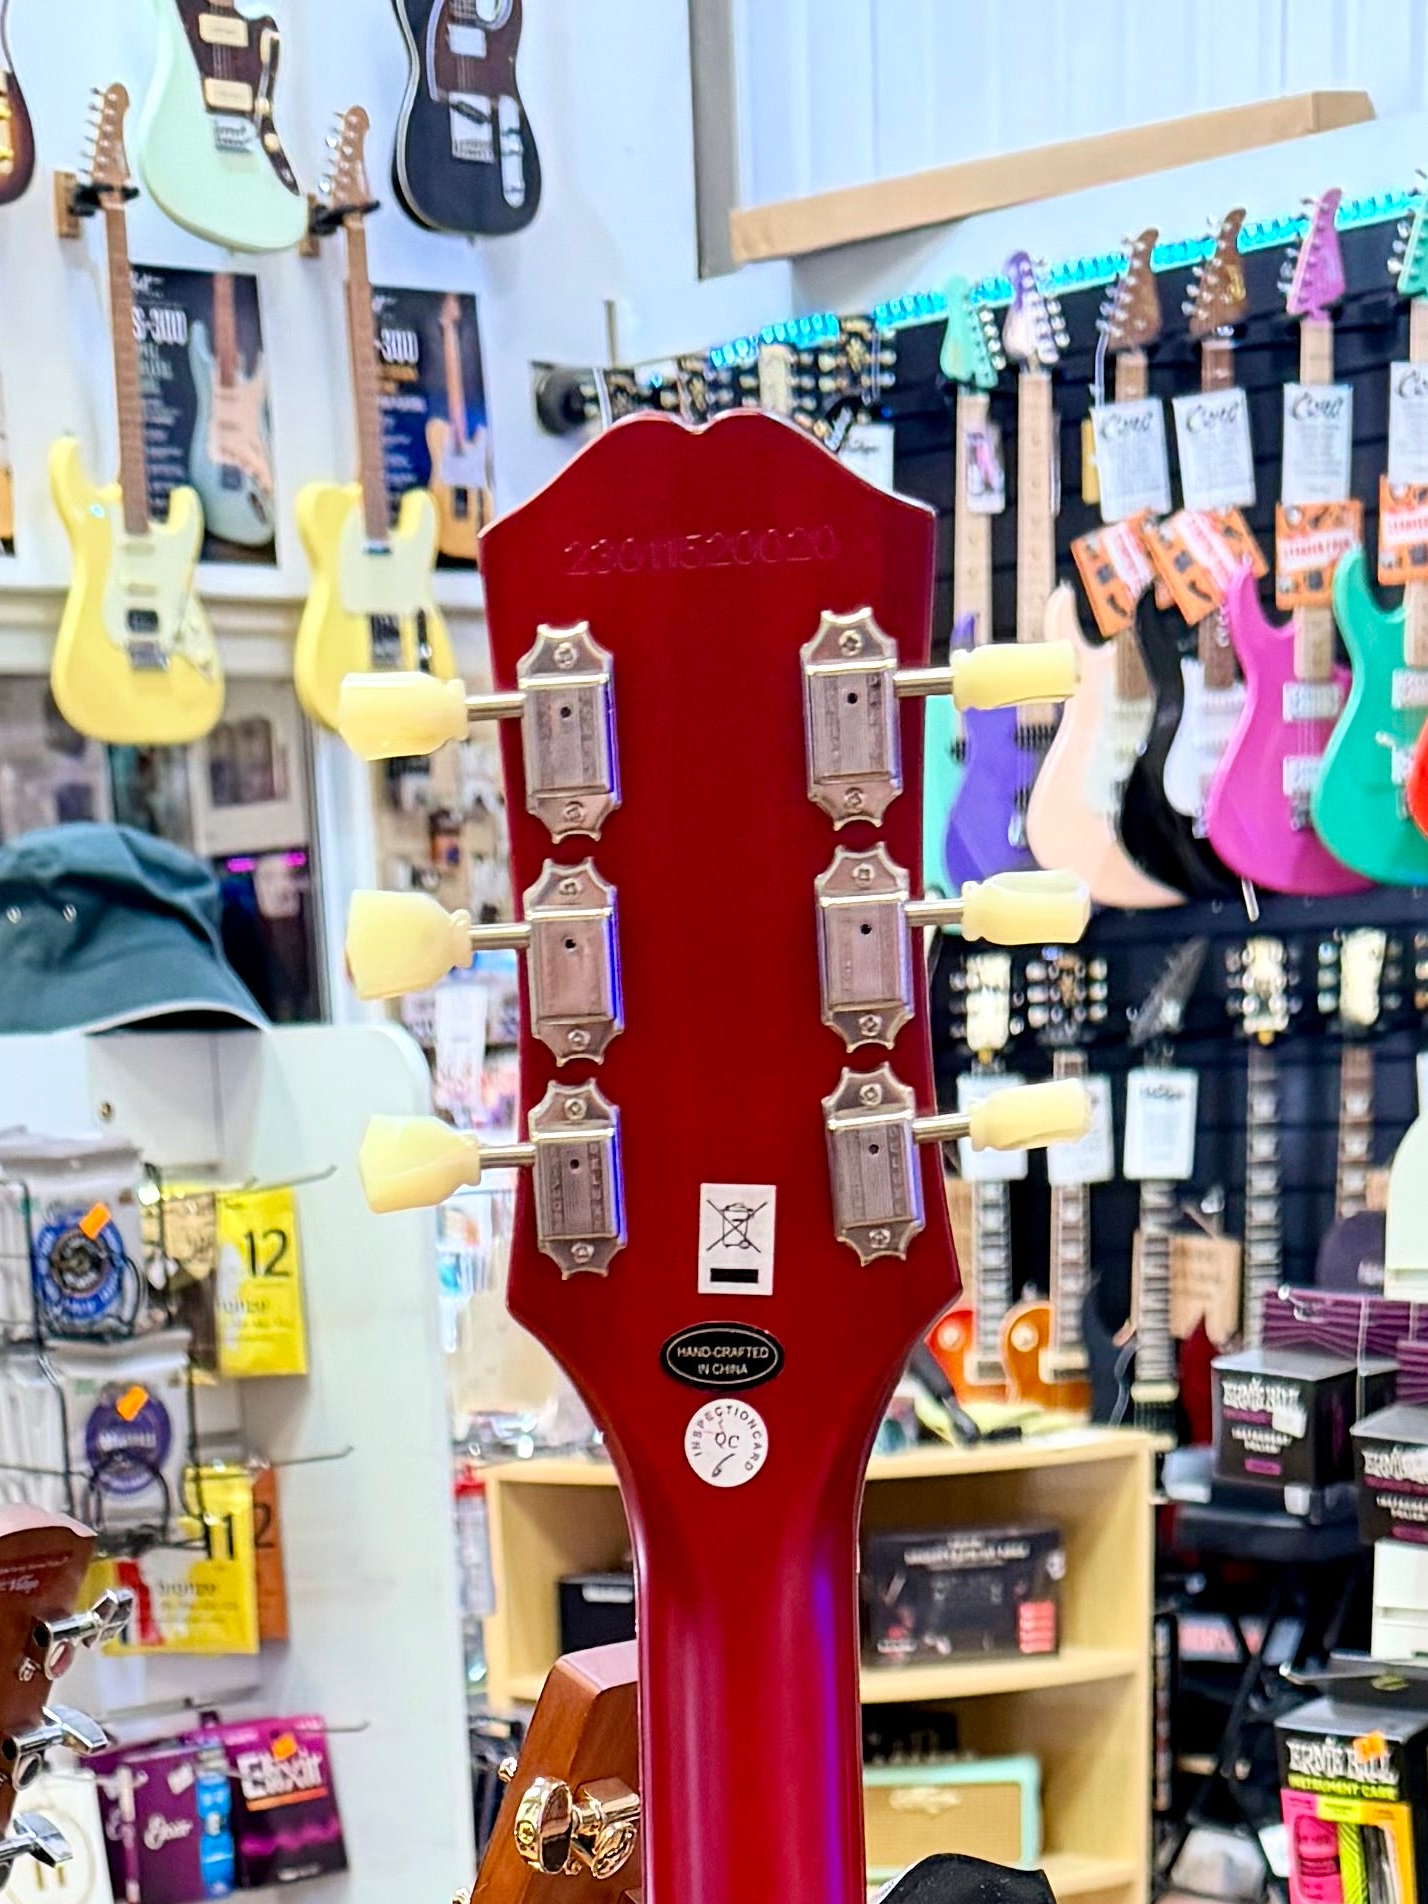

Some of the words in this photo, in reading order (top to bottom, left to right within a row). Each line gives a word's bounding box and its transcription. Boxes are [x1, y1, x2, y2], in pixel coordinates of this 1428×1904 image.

[131, 305, 188, 346] S-300
[245, 1228, 291, 1278] 12
[677, 1346, 769, 1359] HAND-CRAFTED
[698, 1363, 709, 1375] IN
[712, 1363, 748, 1375] CHINA
[714, 1432, 740, 1449] QC
[1286, 1736, 1346, 1778] ERNIE
[237, 1751, 323, 1799] Elixir
[1287, 1772, 1360, 1796] INSTRUMENT
[1361, 1785, 1400, 1800] CARE
